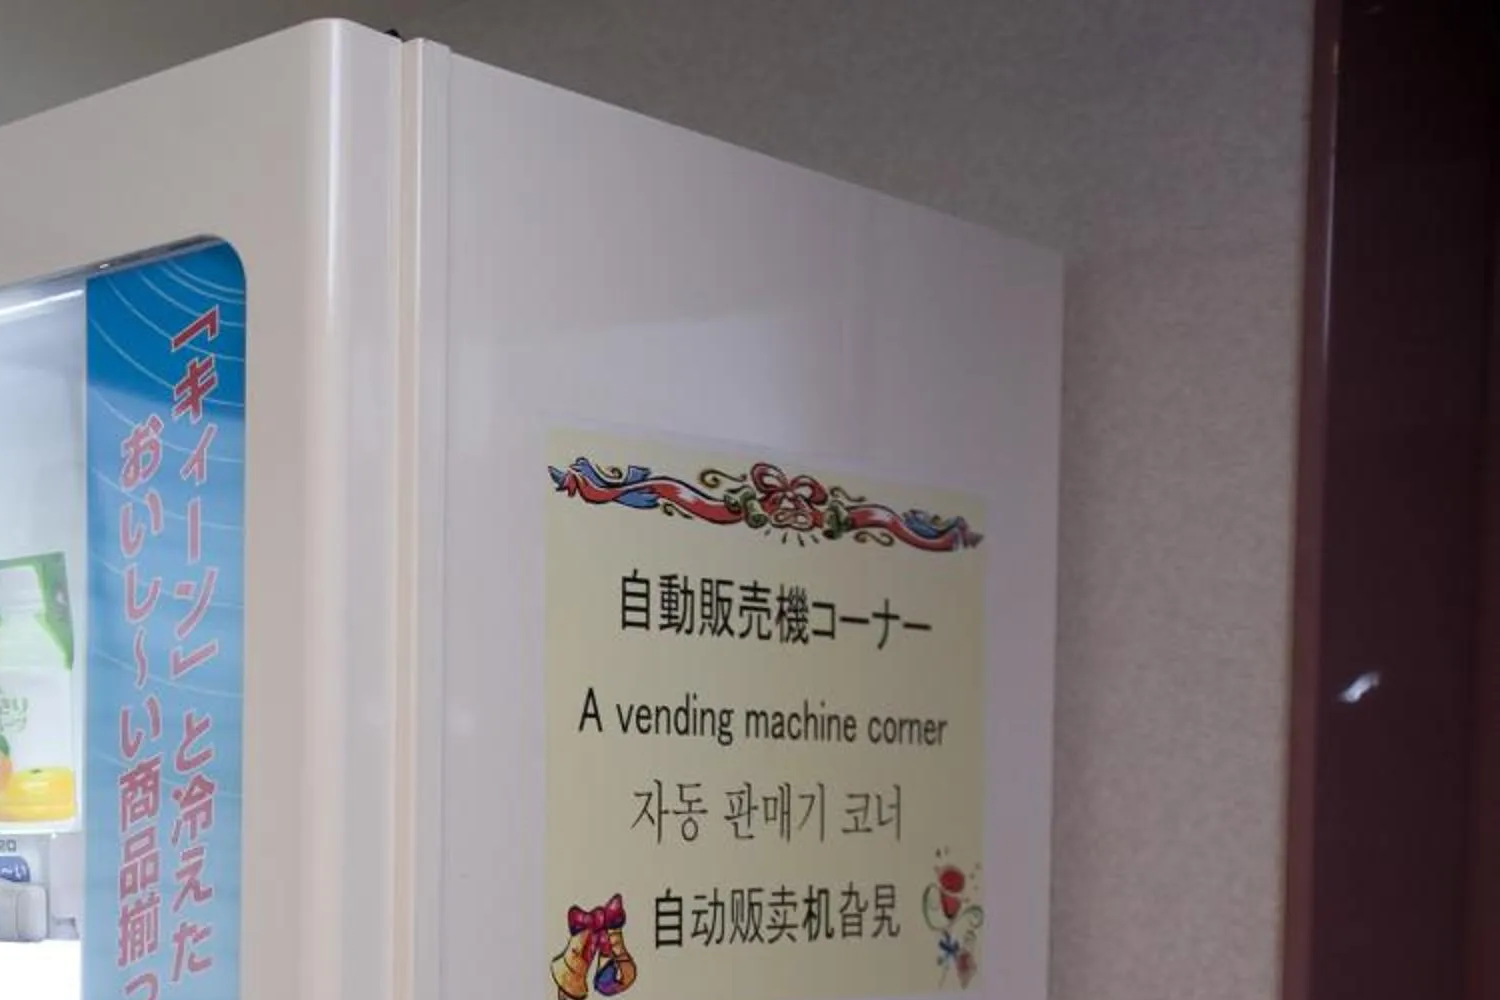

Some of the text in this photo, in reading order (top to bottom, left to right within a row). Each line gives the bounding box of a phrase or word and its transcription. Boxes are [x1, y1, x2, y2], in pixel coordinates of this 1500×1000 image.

[619, 568, 932, 649] 自動販売機コーナー
[579, 687, 948, 746] A vending machine corner
[631, 778, 902, 844] 자동 판매기 코너
